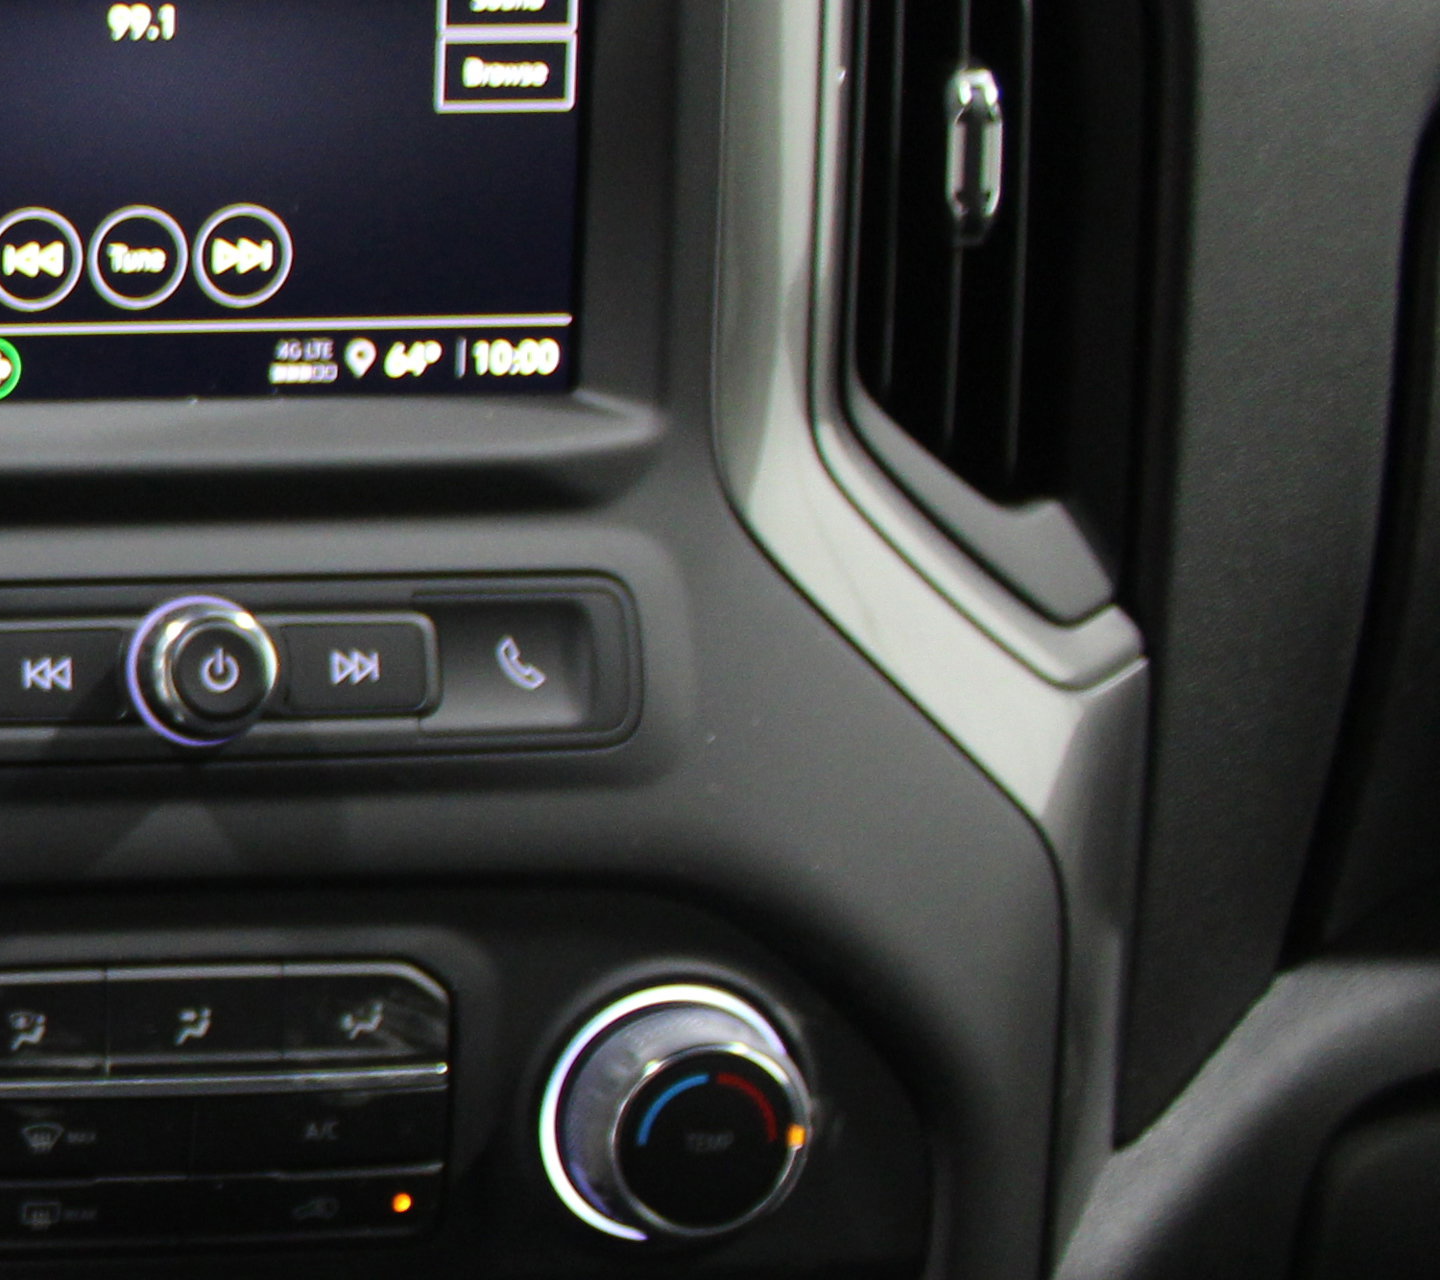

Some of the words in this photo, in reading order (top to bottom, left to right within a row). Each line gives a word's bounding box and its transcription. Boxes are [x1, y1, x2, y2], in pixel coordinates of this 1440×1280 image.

[108, 3, 178, 42] 99.1
[462, 56, 550, 88] Browse
[107, 242, 168, 274] Tune
[276, 339, 303, 361] 4G
[304, 338, 335, 361] LTE
[473, 337, 561, 377] 10:00
[304, 1121, 339, 1142] A/C
